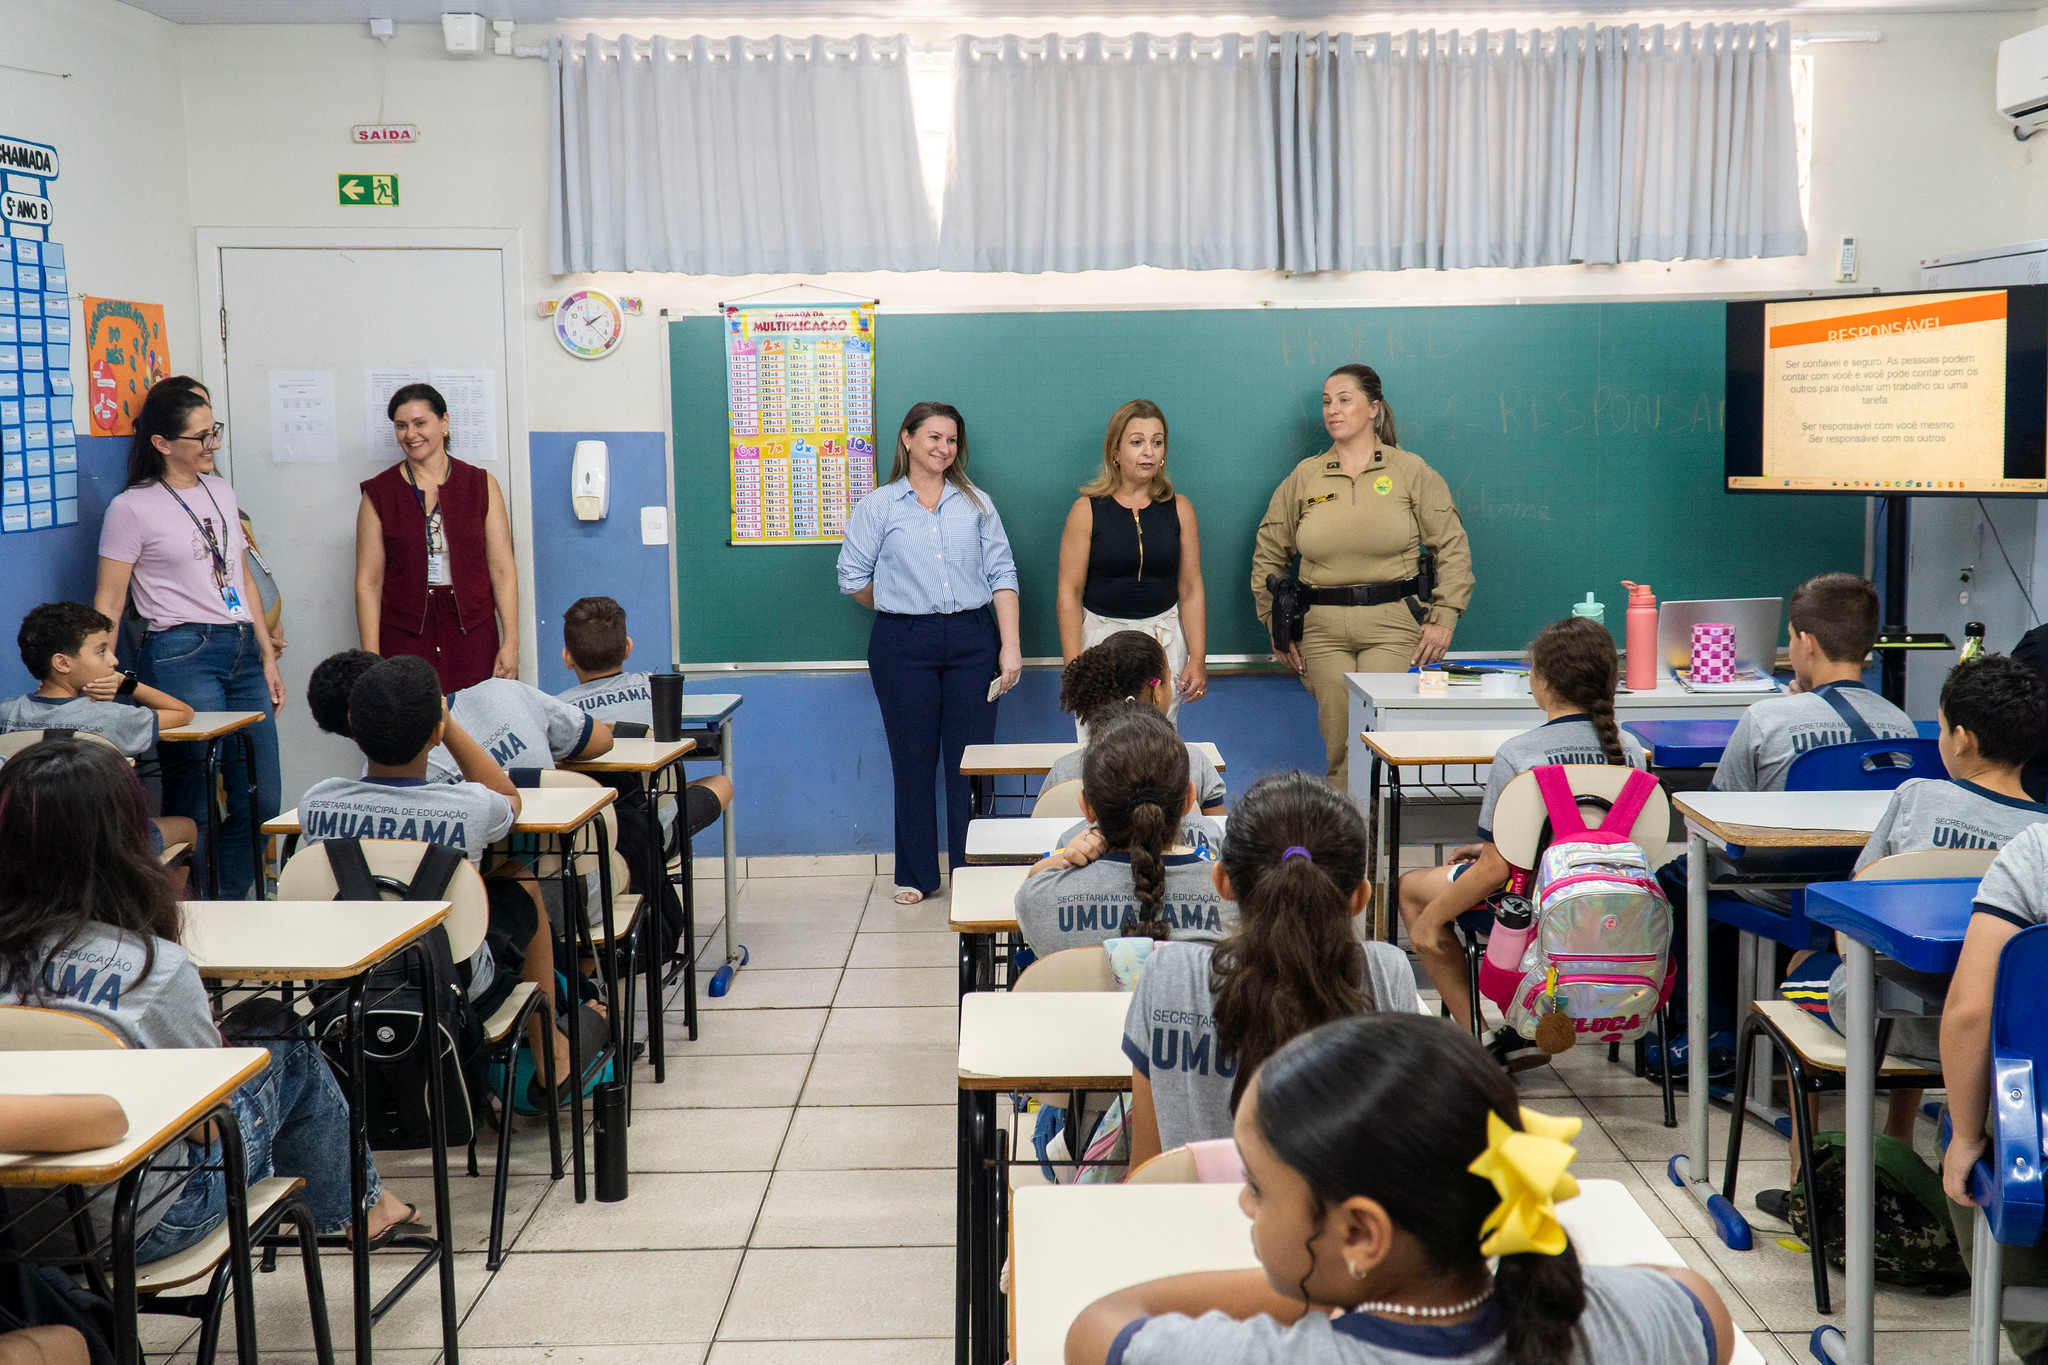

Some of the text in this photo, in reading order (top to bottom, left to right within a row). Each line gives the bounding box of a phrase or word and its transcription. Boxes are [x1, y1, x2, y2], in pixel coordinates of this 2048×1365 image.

[359, 128, 411, 140] SAÍDA
[17, 200, 37, 219] ANO
[41, 203, 48, 220] B
[753, 316, 847, 332] MULTIPLICAÇÃO
[1828, 317, 1940, 342] RESPONSÁVEL
[108, 326, 120, 342] DO
[1785, 360, 1800, 369] Ser
[1803, 358, 1840, 368] confiável
[1887, 357, 1898, 365] As
[1902, 356, 1939, 366] pessoas
[1942, 354, 1975, 365] podem
[1782, 372, 1808, 381] contar
[1811, 372, 1829, 380] com
[1832, 370, 1853, 379] você
[1864, 370, 1884, 378] você
[1887, 370, 1910, 379] pode
[1912, 369, 1940, 377] contar
[1790, 384, 1817, 393] outros
[1819, 385, 1839, 394] para
[1842, 383, 1874, 391] realizar
[1893, 381, 1930, 390] trabalho
[1801, 421, 1816, 430] Ser
[1819, 420, 1872, 432] responsável
[1896, 421, 1917, 429] você
[1808, 434, 1823, 444] Ser
[1826, 433, 1879, 444] responsável
[1917, 434, 1946, 442] outros
[573, 687, 650, 711] MUARAMA
[1788, 722, 1836, 733] SECRETARIA
[310, 800, 351, 809] SECRETARIA
[353, 803, 399, 814] MUNICIPAL
[417, 809, 468, 820] EDUCAÇÃO
[307, 810, 466, 848] UMUARAMA
[1935, 818, 1980, 834] SECRETARIA
[1057, 894, 1108, 904] SECRETARIA
[1172, 893, 1220, 904] EDUCAÇÃO
[1058, 903, 1222, 932] UMUAAMA
[60, 950, 132, 972] EDUCAÇÃO
[1153, 1009, 1218, 1028] SECRETAR
